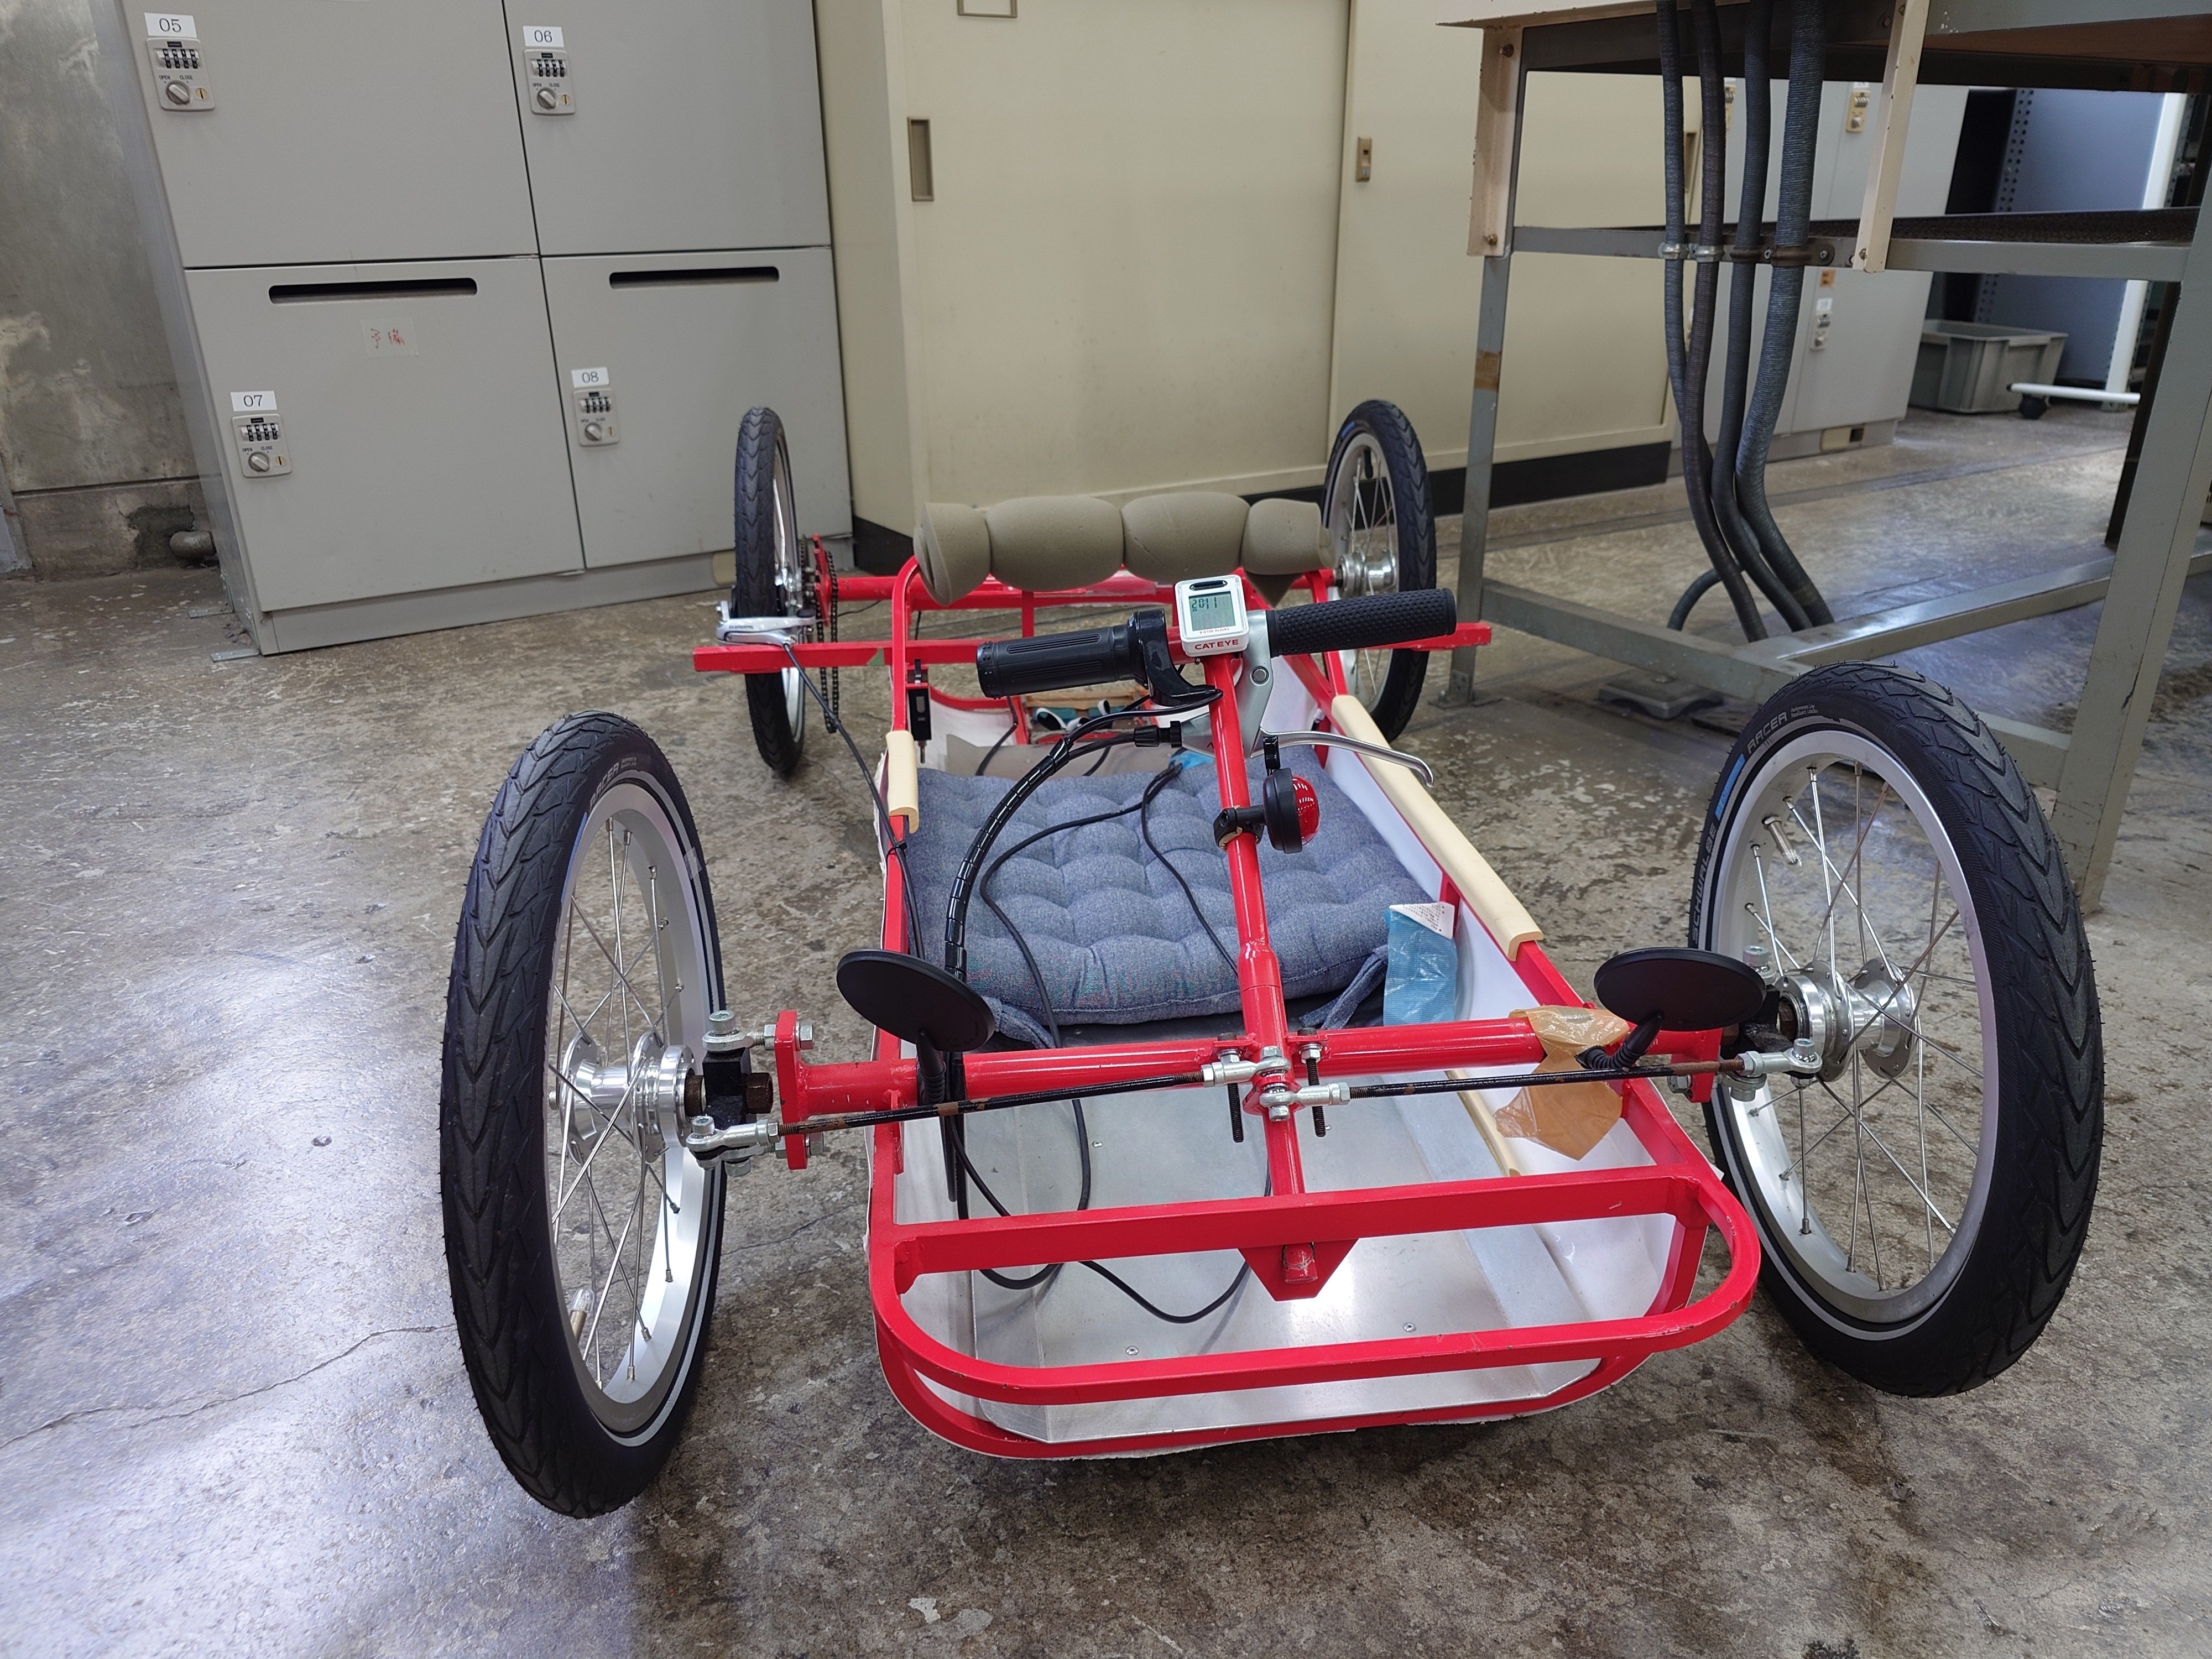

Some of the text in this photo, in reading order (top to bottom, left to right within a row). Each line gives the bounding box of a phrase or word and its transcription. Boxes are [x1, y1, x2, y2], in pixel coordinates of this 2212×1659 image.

[159, 18, 182, 33] 05
[534, 30, 552, 43] 06
[582, 371, 599, 384] 08
[243, 394, 263, 407] 07
[1194, 639, 1239, 650] CATEYE
[1747, 711, 1788, 754] RACER
[589, 761, 619, 812] RACER
[1692, 822, 1717, 945] SCHWALBE
